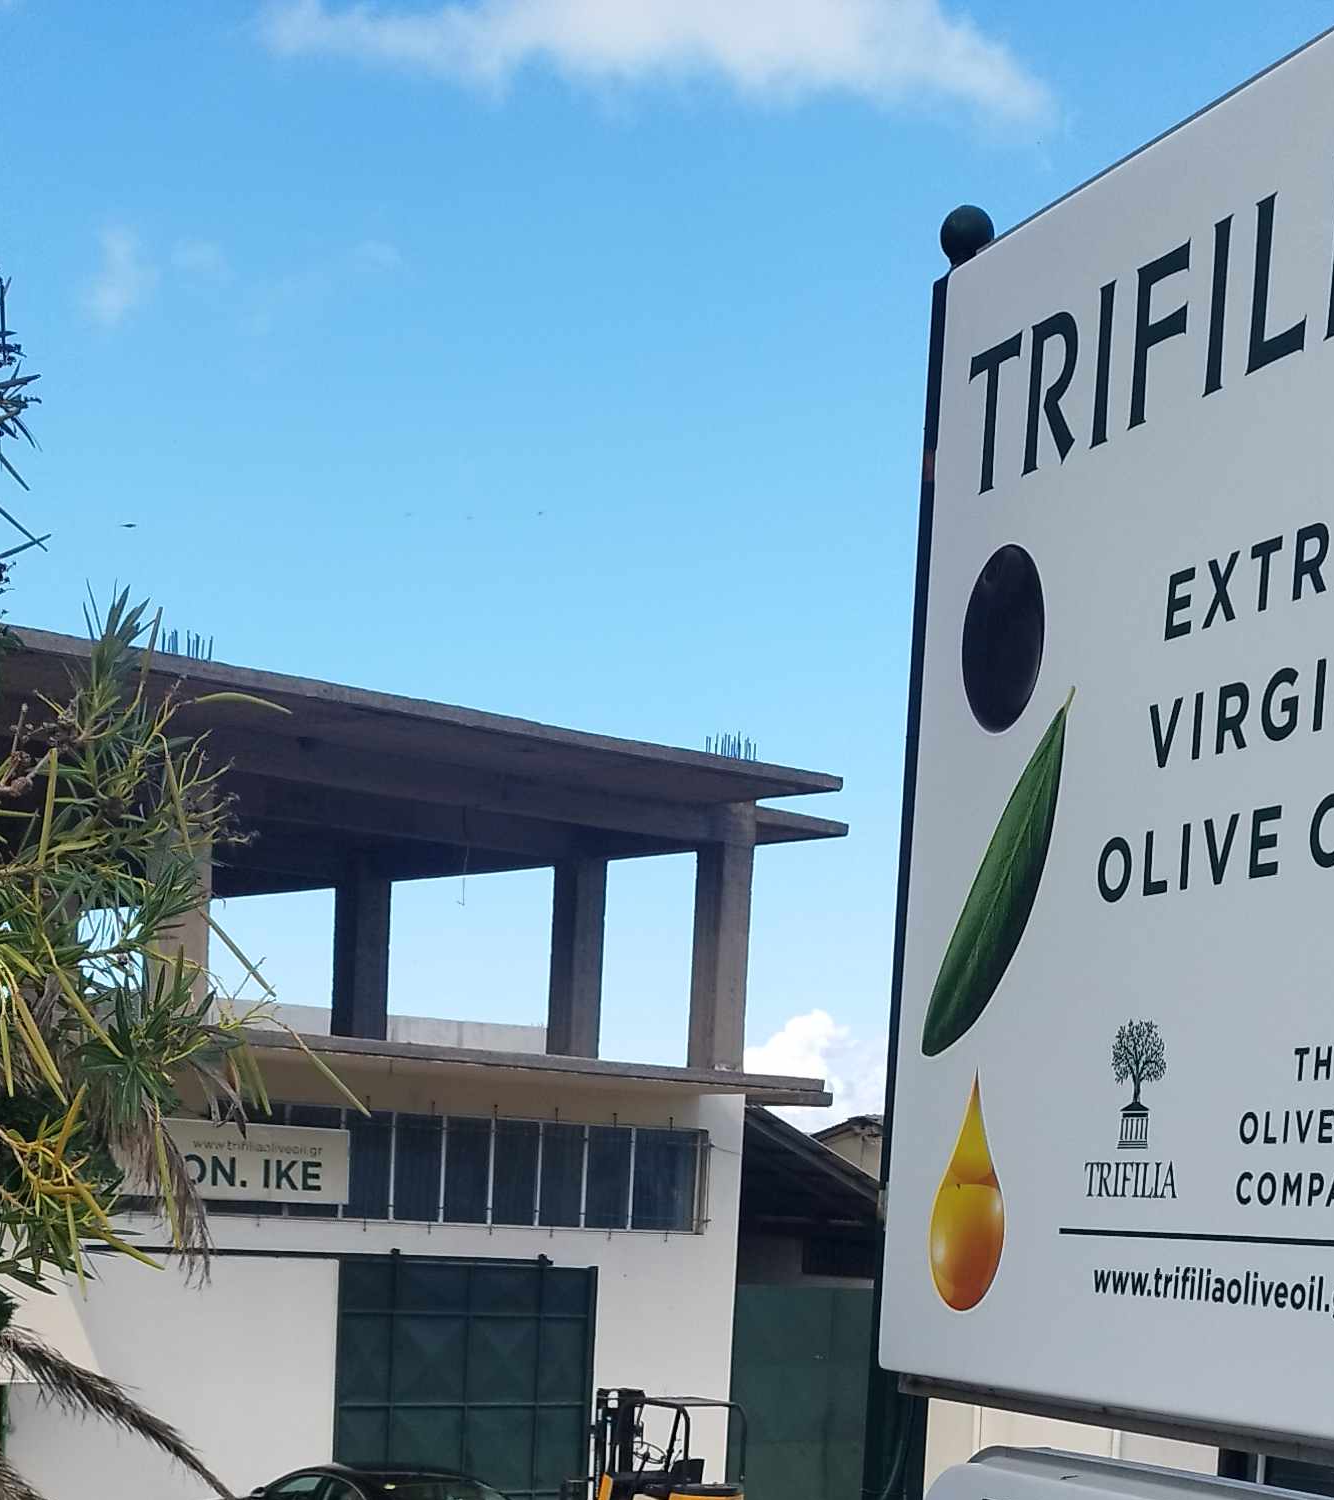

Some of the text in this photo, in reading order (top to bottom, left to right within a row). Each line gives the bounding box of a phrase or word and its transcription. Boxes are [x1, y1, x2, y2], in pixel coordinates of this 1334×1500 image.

[1097, 805, 1282, 903] OLIVE
[1238, 1109, 1334, 1144] OLIVE
[1084, 1160, 1178, 1200] TRIFILIA
